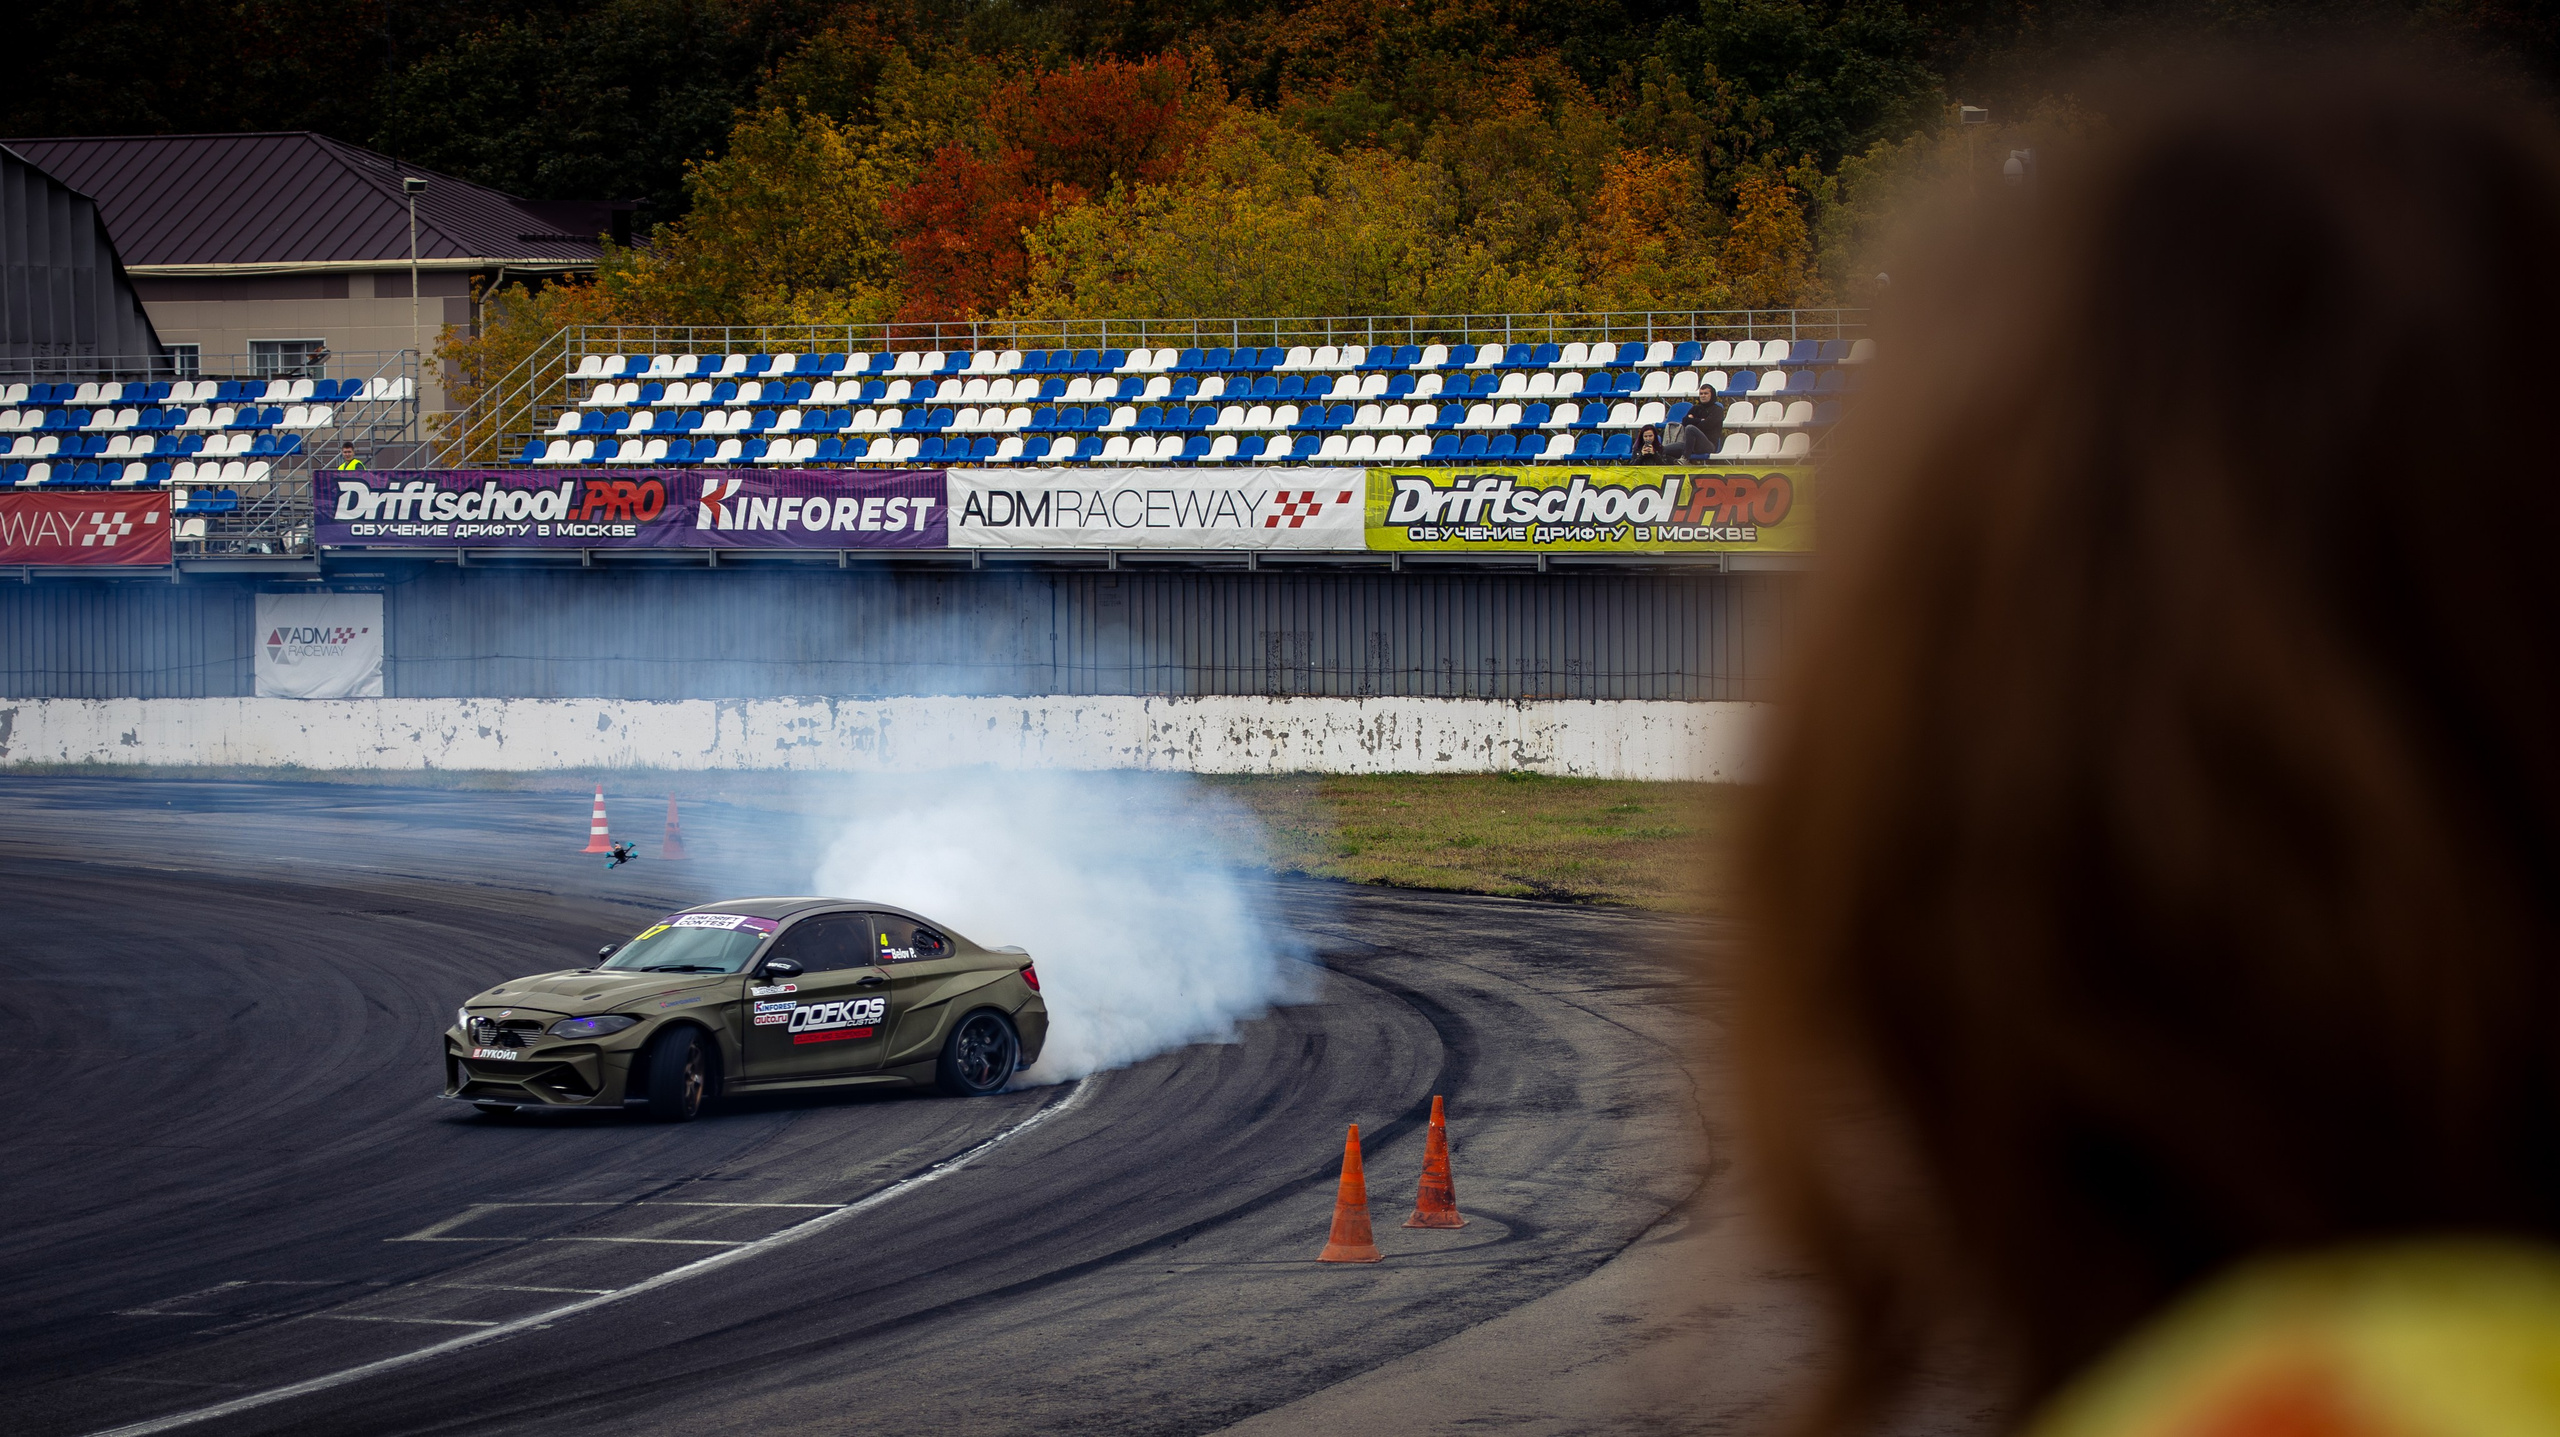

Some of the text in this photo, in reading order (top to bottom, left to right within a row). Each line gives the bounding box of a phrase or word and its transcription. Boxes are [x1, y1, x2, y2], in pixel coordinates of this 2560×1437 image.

[335, 480, 665, 521] Driftschool.PRO
[696, 478, 936, 531] KINFOREST
[1388, 477, 1789, 523] Driftschool.PRO
[959, 489, 1268, 528] ADMRACEWAY
[351, 523, 449, 537] ОБУЧЕНИЕ
[454, 523, 530, 538] ДРИФТУ
[538, 524, 550, 537] В
[1409, 526, 1527, 541] ОБУЧЕНИЕ
[1534, 526, 1626, 543] ДРИФТУ
[1636, 527, 1650, 541] В
[289, 627, 331, 645] ADM
[288, 645, 347, 657] RACEWAY
[679, 920, 736, 928] CONTEST
[709, 915, 741, 923] DRIFT
[756, 1001, 796, 1012] KINFOREST
[754, 1014, 788, 1025] auto.ru
[847, 1017, 882, 1027] CUSTOM
[480, 1049, 518, 1061] ЛУКОЙЛ
